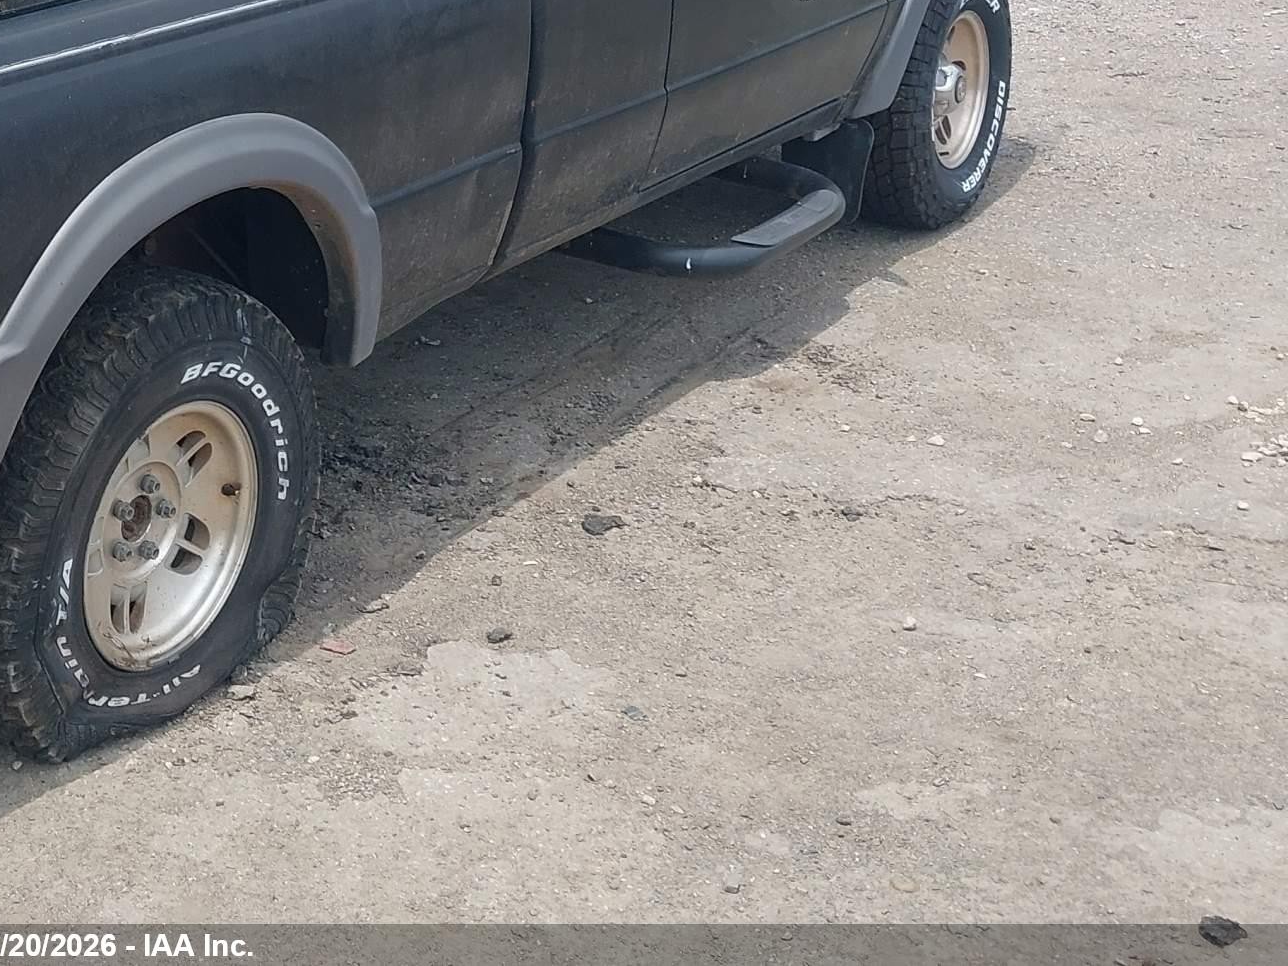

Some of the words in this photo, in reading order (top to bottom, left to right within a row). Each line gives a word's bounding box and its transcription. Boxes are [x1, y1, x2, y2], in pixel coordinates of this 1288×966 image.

[961, 79, 1005, 194] DISCOVERER
[180, 360, 290, 501] BFGoodrich
[55, 558, 74, 626] T/A
